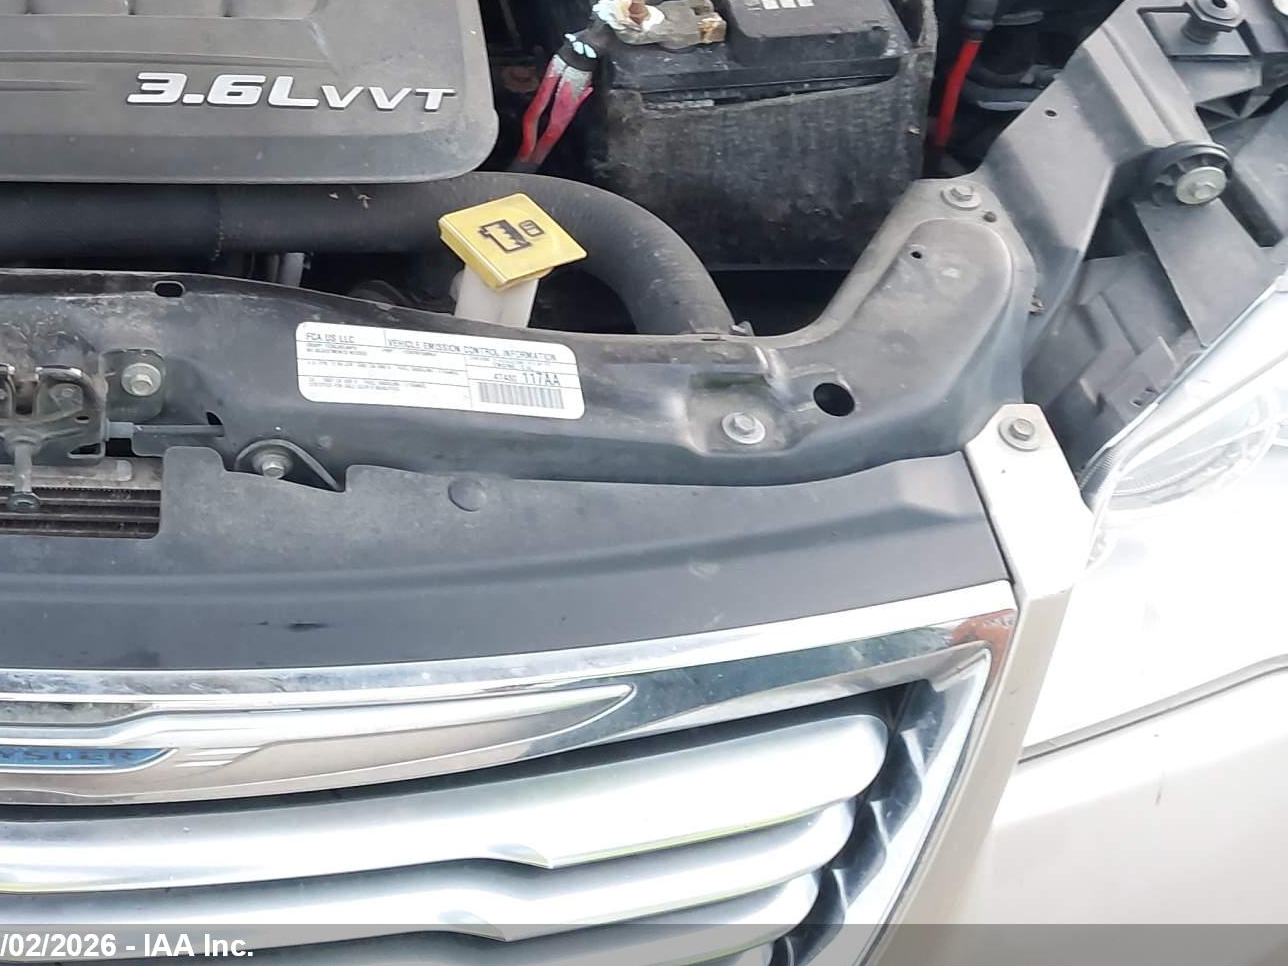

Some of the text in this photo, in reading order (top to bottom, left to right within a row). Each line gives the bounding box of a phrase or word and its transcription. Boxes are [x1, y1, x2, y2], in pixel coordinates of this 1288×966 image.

[387, 338, 420, 349] VEHICLE
[423, 341, 461, 354] EMISSION
[463, 345, 501, 357] CONTROL
[503, 349, 557, 361] INFORMATION
